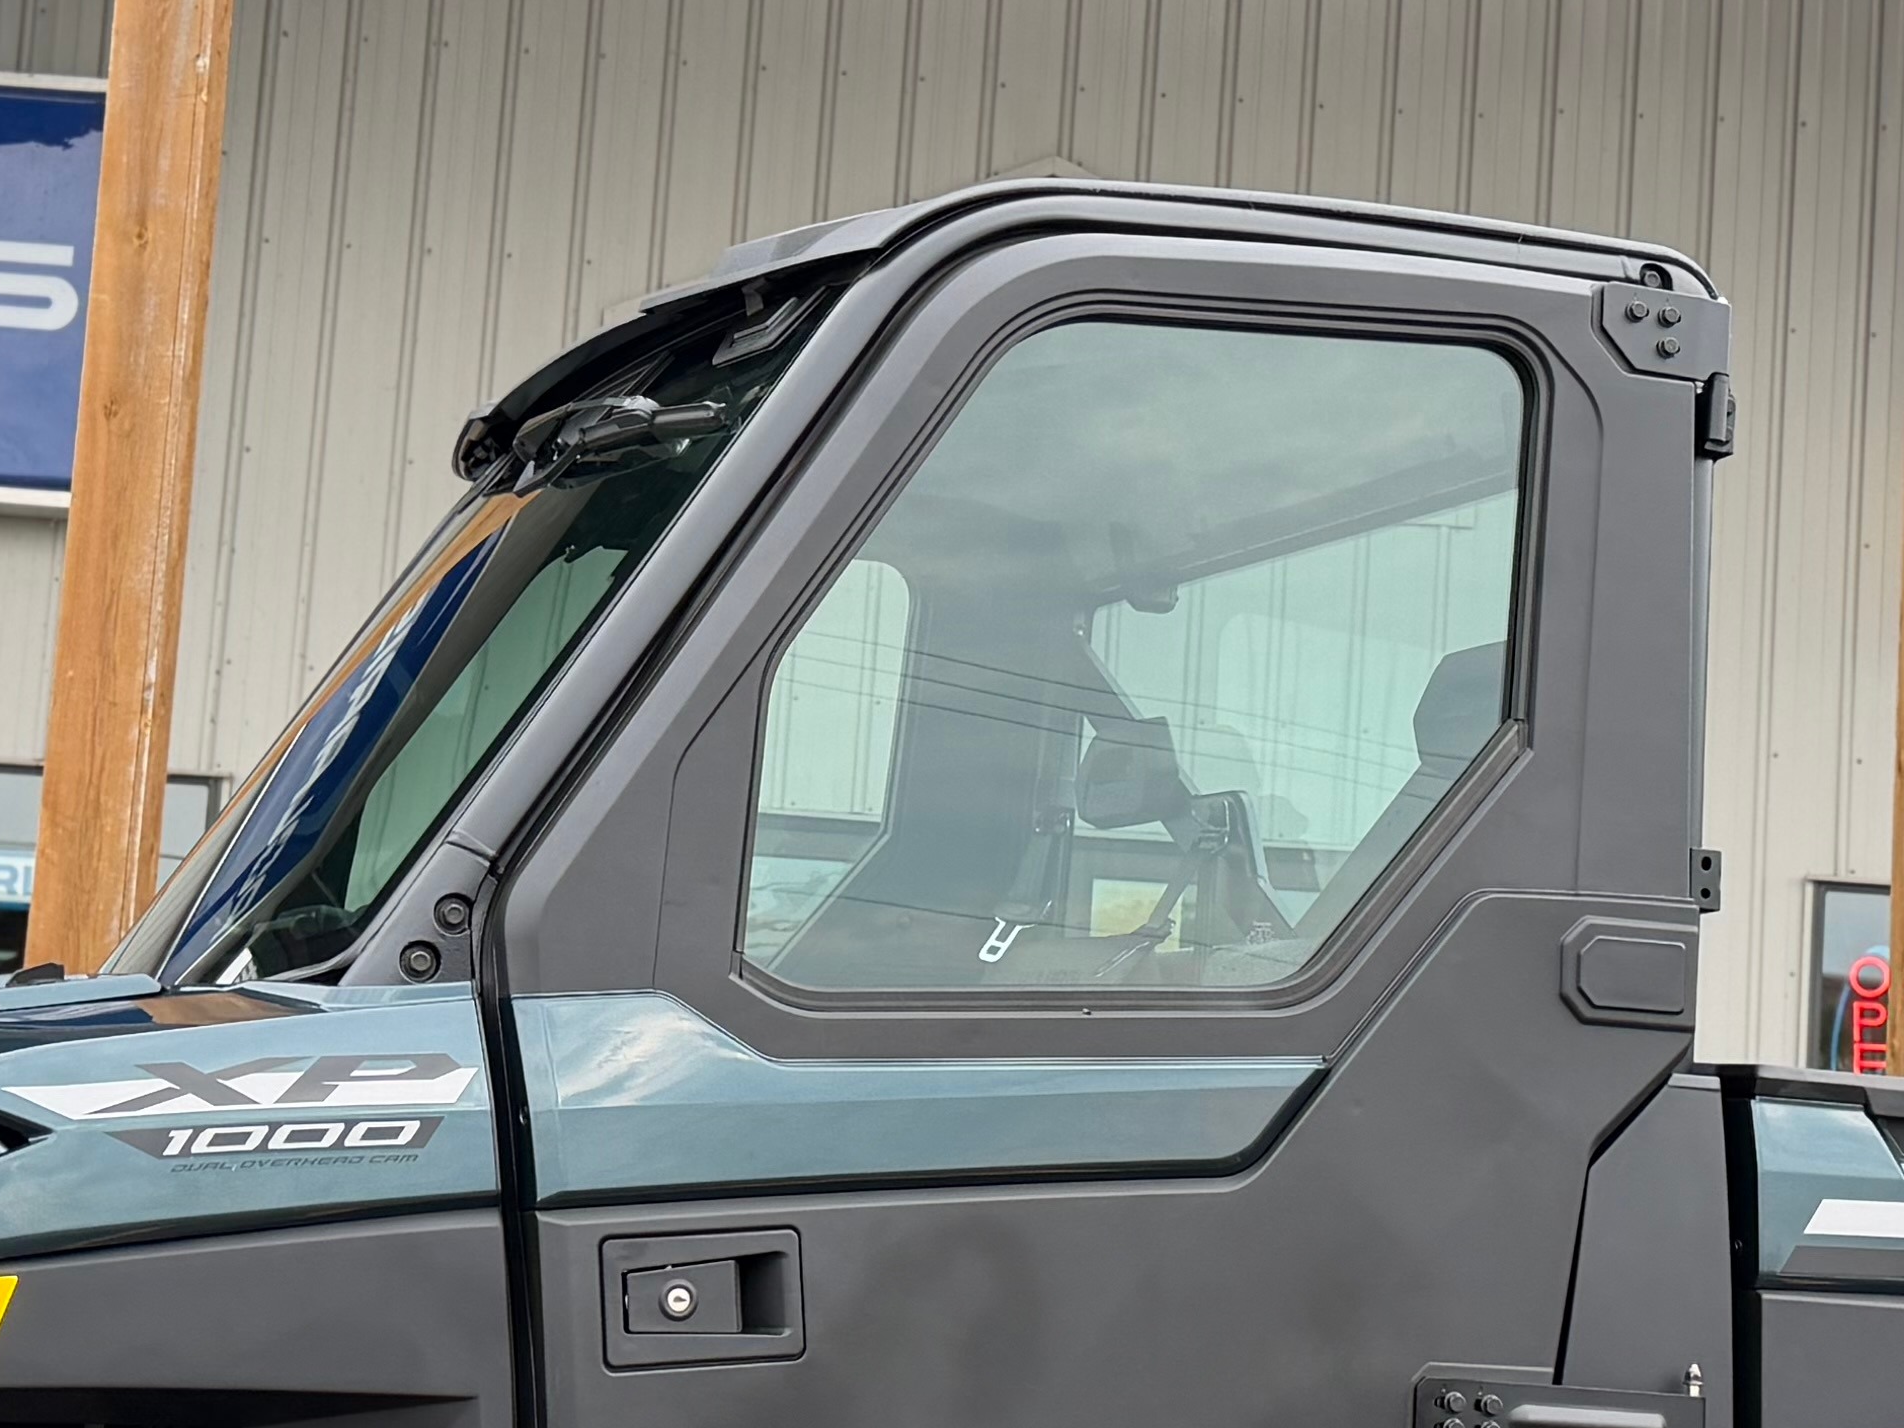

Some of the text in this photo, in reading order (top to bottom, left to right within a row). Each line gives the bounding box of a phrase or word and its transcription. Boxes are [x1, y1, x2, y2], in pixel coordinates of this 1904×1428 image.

[1848, 955, 1891, 1075] OPE
[81, 1052, 465, 1116] XP
[162, 1120, 422, 1157] 1000
[240, 1155, 364, 1169] OVERHEAD
[368, 1153, 420, 1164] CAM
